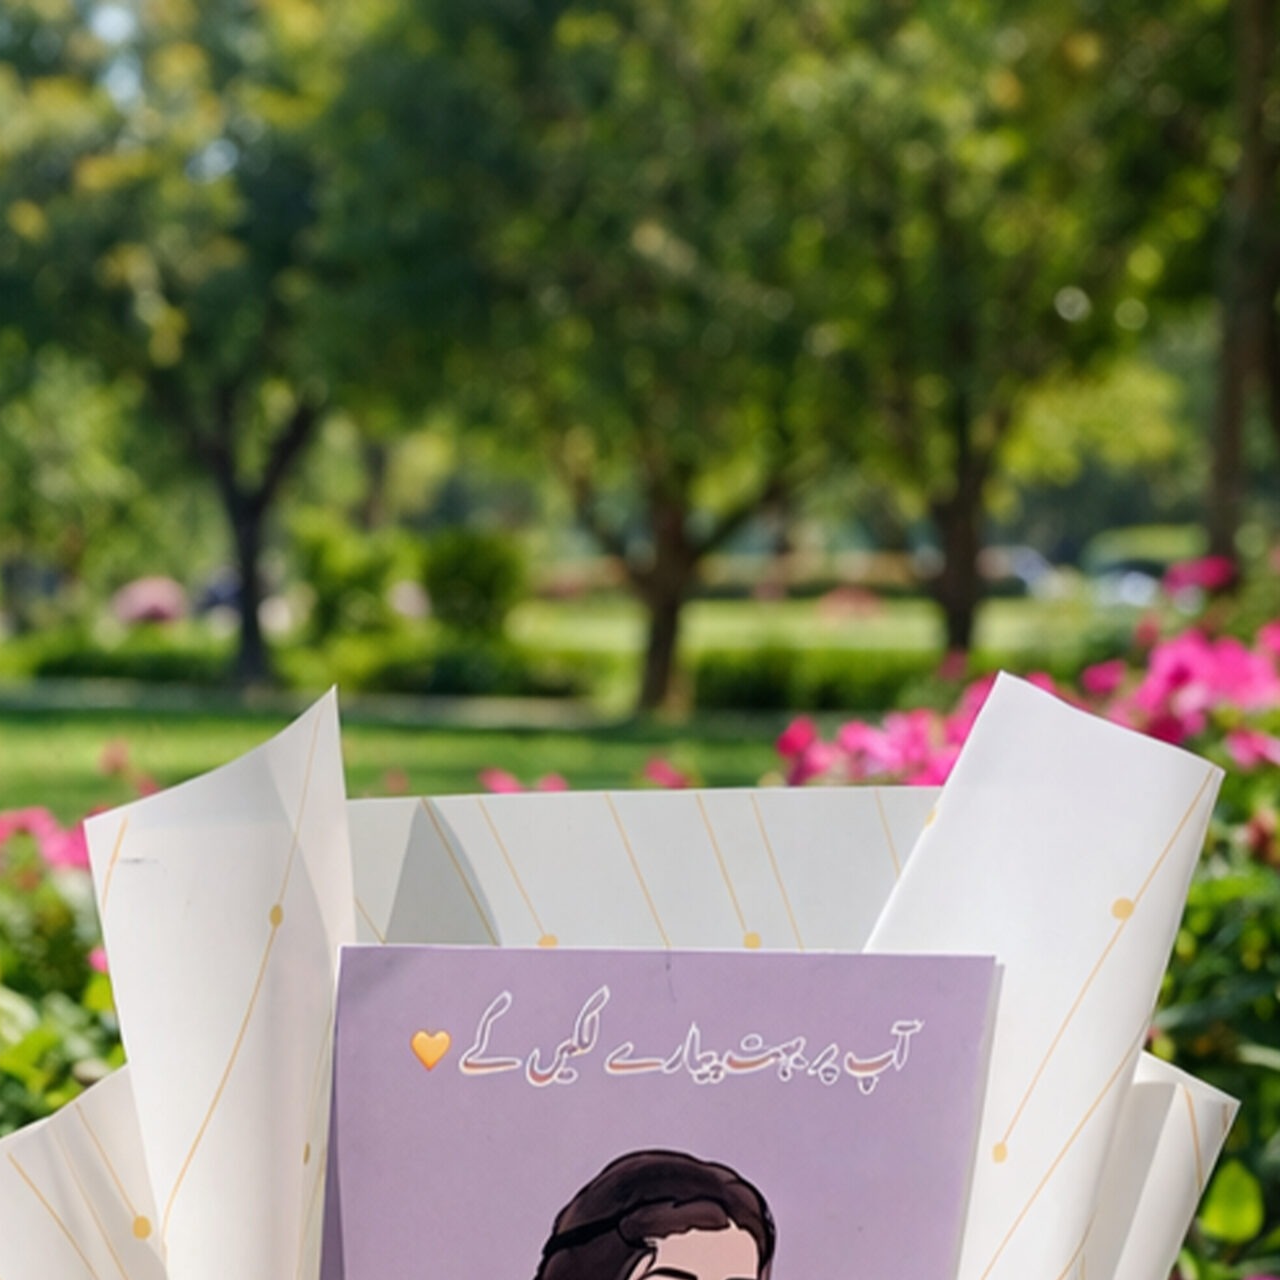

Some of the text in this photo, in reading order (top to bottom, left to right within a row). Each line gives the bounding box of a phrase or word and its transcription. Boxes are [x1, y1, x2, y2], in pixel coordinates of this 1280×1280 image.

[604, 1021, 725, 1085] پیارے
[723, 1033, 809, 1082] بہت
[807, 1043, 840, 1086] پر
[844, 1019, 926, 1095] آپ
